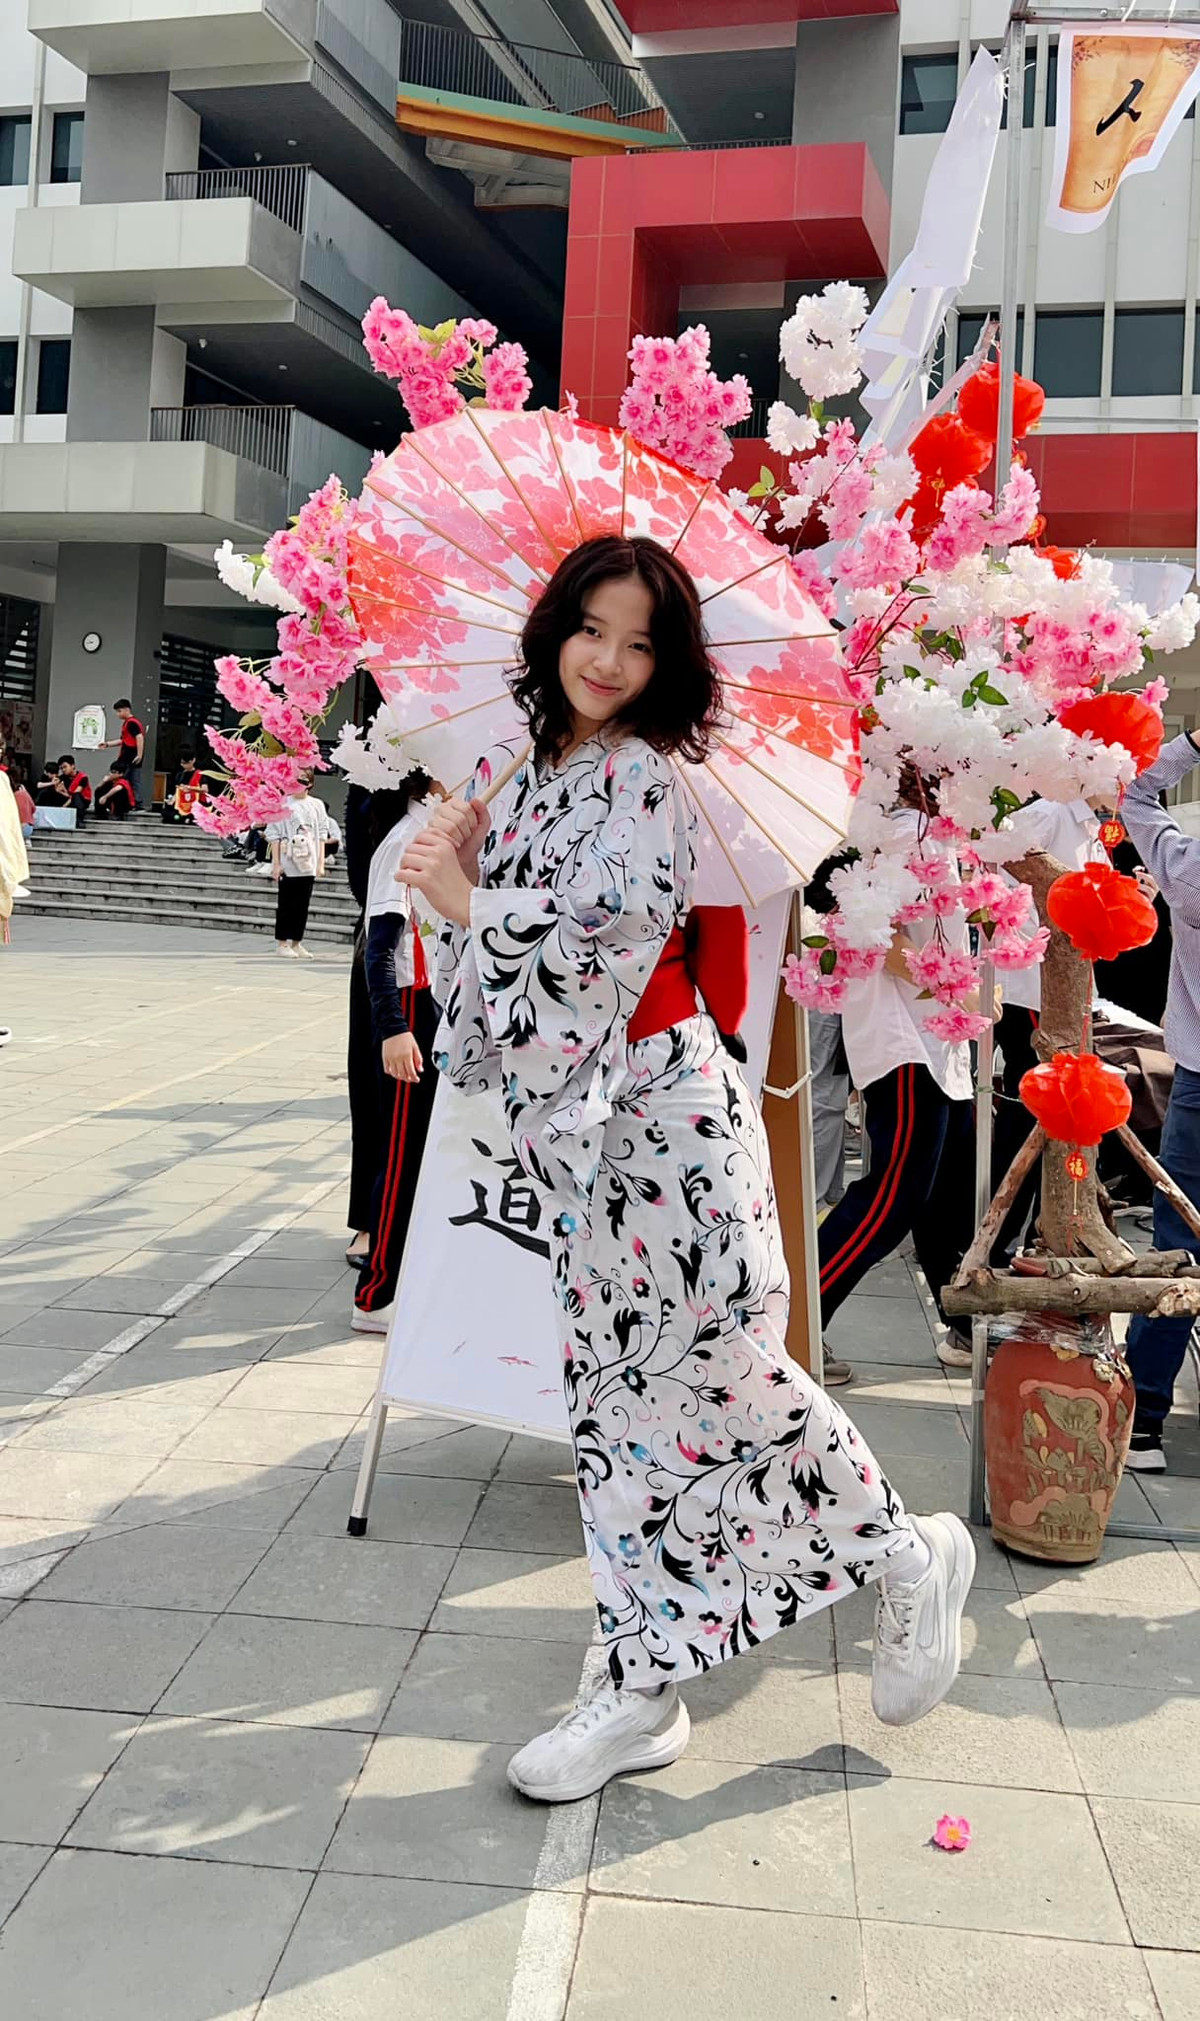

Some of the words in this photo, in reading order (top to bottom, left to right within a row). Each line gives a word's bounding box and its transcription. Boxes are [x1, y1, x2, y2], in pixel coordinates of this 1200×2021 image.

[1096, 78, 1145, 136] 人
[1069, 1156, 1084, 1177] 福
[448, 1137, 551, 1260] 道
